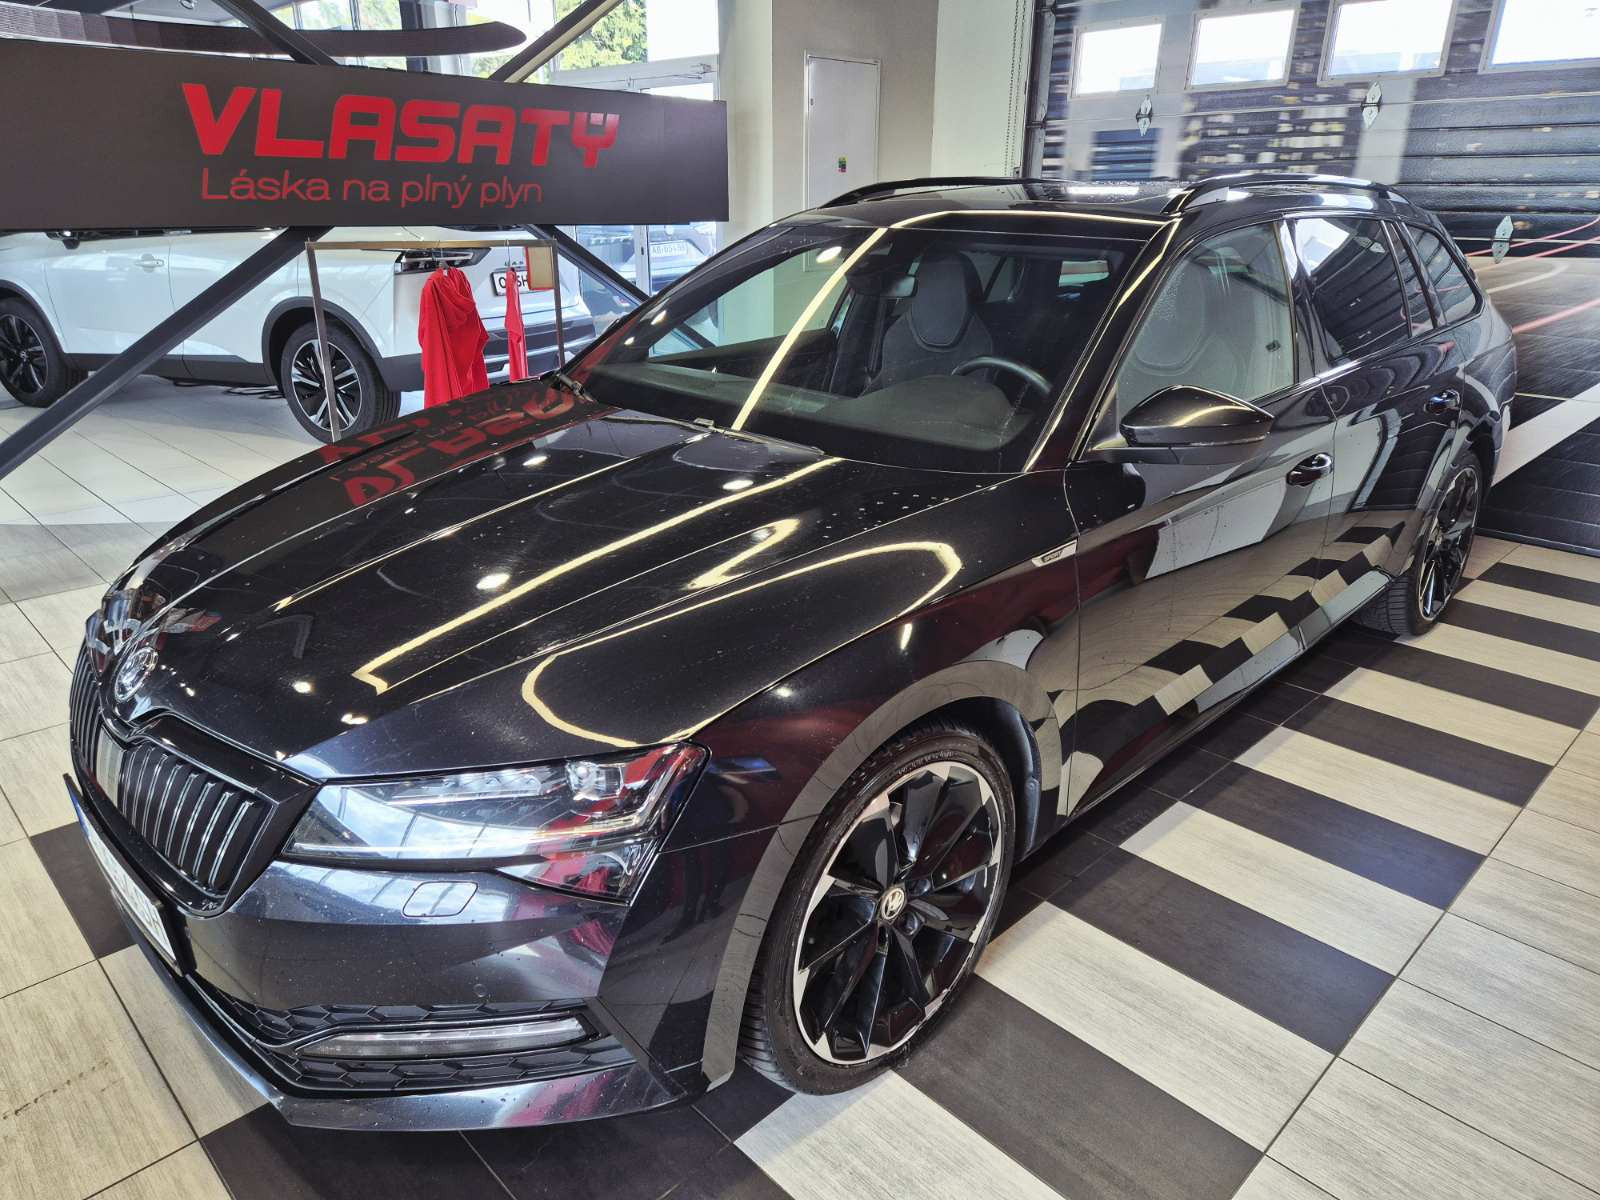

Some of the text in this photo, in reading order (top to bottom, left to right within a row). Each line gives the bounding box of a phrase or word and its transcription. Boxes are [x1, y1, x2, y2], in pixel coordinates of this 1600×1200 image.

[182, 83, 620, 168] VLASATY
[202, 168, 543, 209] Láska na plný plyn
